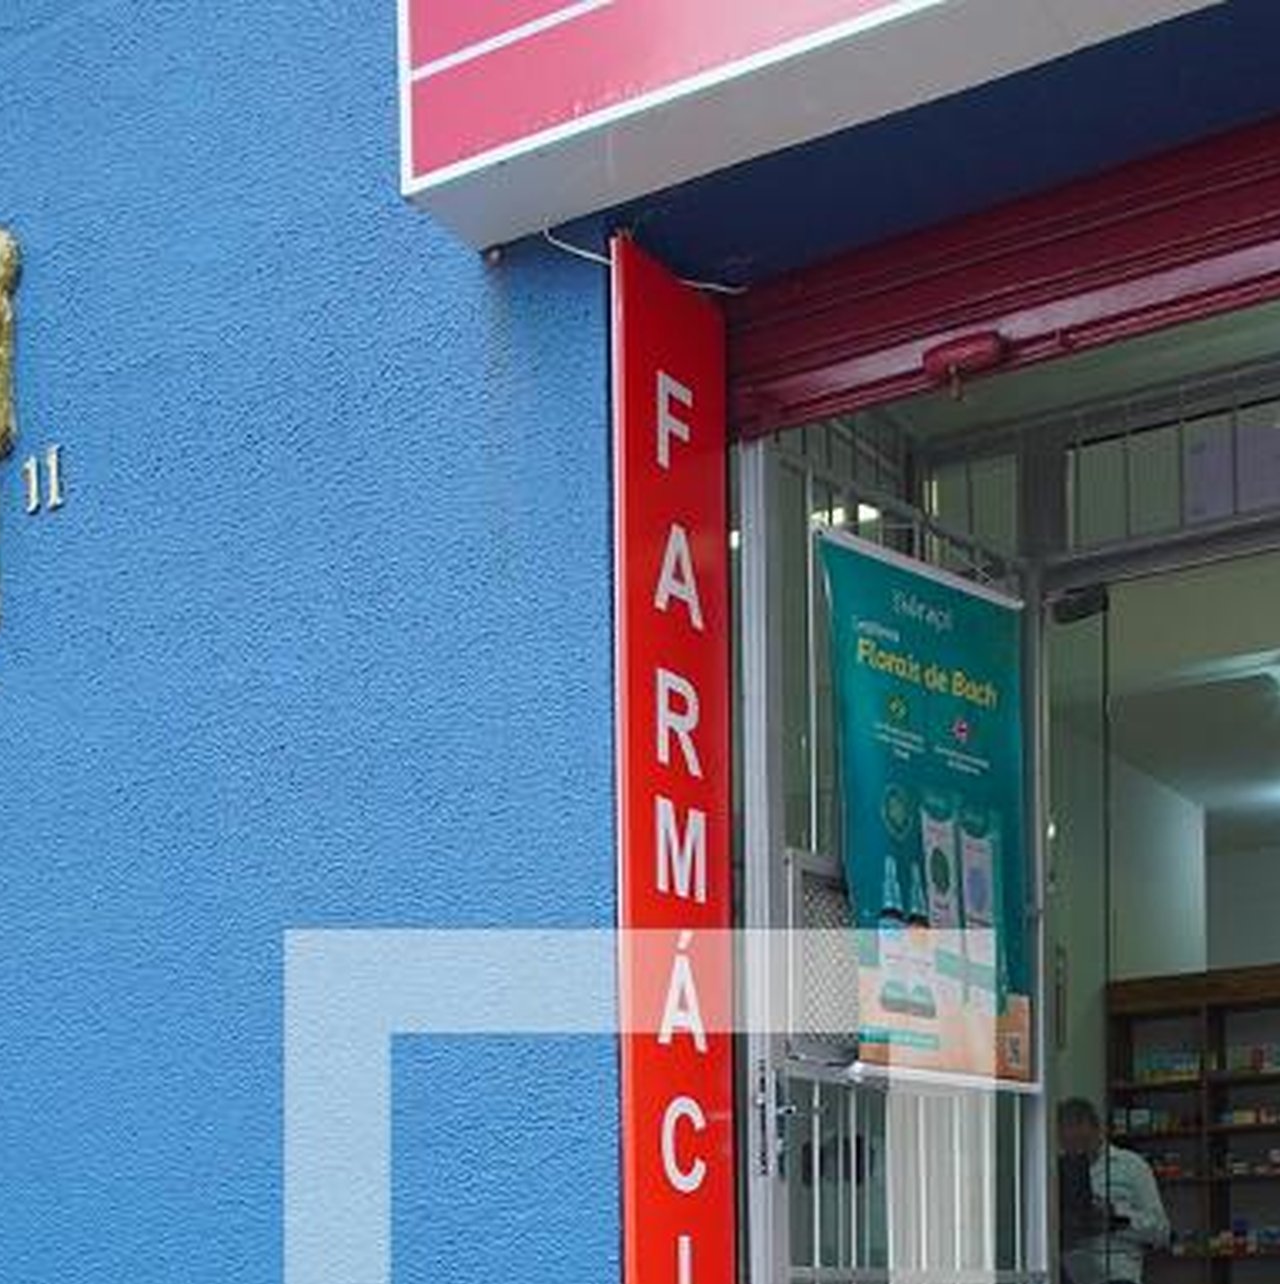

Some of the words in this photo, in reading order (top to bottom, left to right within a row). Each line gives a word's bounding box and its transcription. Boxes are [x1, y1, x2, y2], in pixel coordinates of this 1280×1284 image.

[22, 444, 62, 513] 11
[856, 636, 921, 684] Florais
[924, 663, 949, 692] de
[952, 670, 1000, 711] Bach
